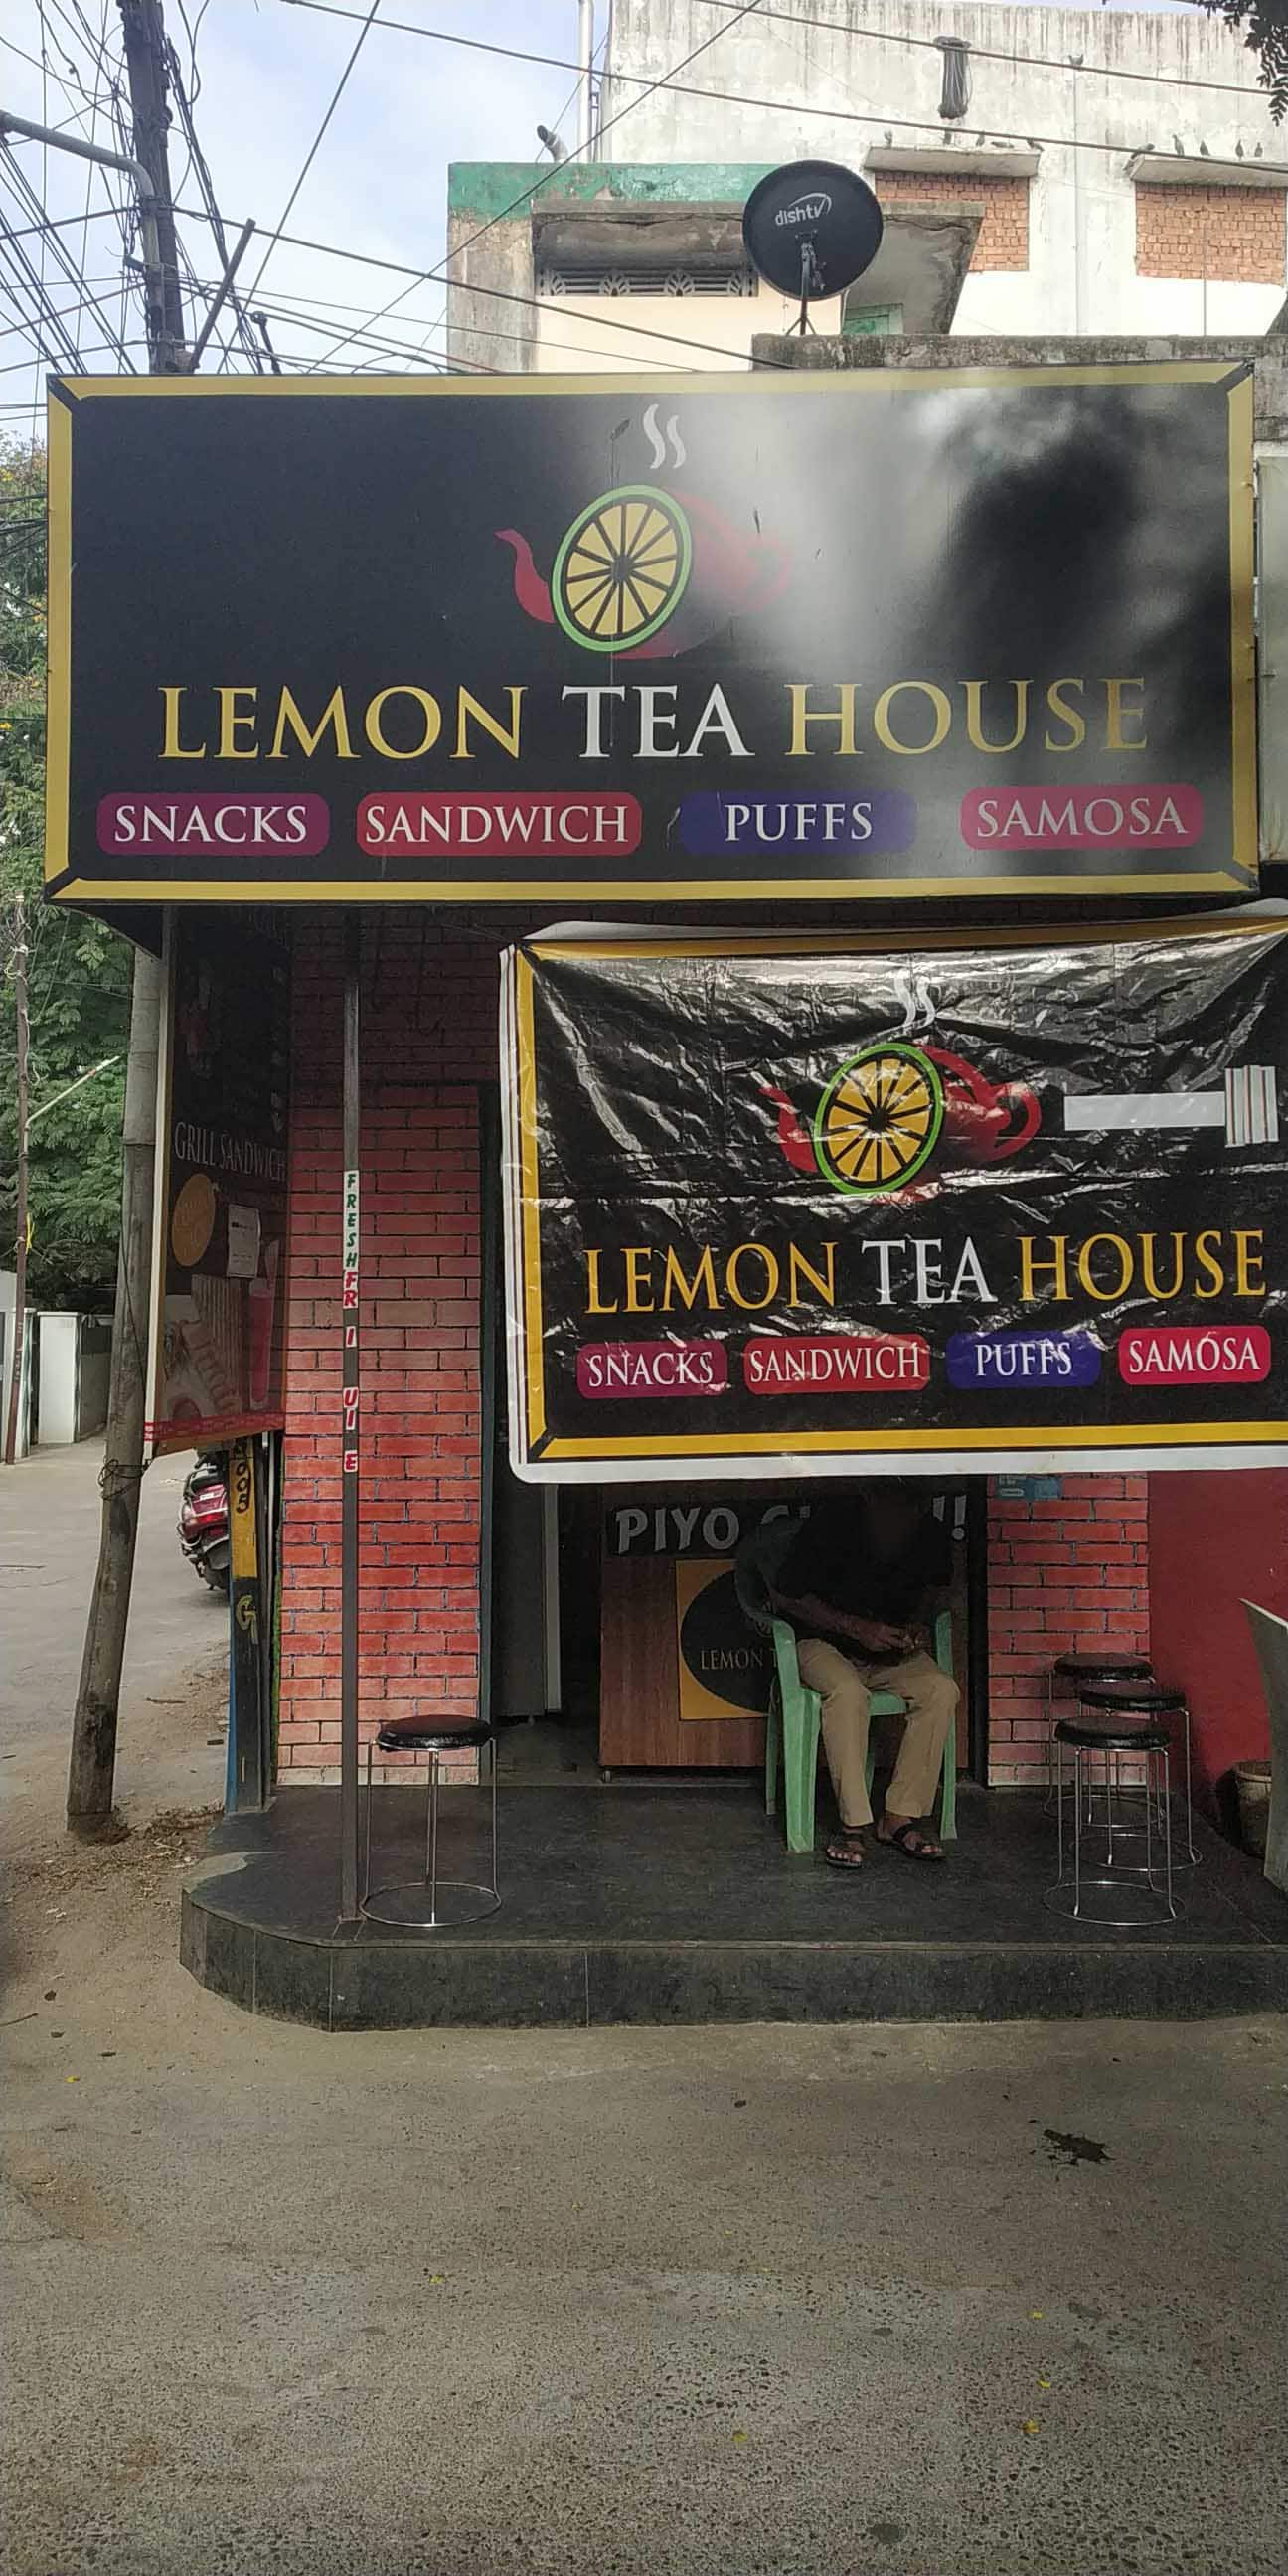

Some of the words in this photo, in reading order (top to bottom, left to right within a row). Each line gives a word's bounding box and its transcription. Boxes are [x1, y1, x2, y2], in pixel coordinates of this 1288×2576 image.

[157, 685, 529, 760] LEMON
[561, 683, 755, 758] TEA
[783, 678, 1148, 756] HOUSE
[114, 805, 308, 843] SNACKS
[365, 805, 629, 843] SANDWICH
[724, 802, 874, 842] PUFFS
[976, 798, 1190, 838] SAMOSA
[174, 1121, 217, 1167] GRILL
[219, 1132, 287, 1183] SANDWICH
[346, 1173, 358, 1268] FRESH
[583, 1242, 839, 1314] LEMON
[861, 1237, 998, 1305] TEA
[1019, 1230, 1266, 1301] HOUSE
[588, 1350, 715, 1388] SNACKS
[749, 1345, 923, 1383] SANDWICH
[975, 1340, 1073, 1377] PUFFS
[1128, 1333, 1261, 1373] SAMOSA
[616, 1506, 739, 1555] PIYO
[700, 1649, 764, 1671] LEMON
